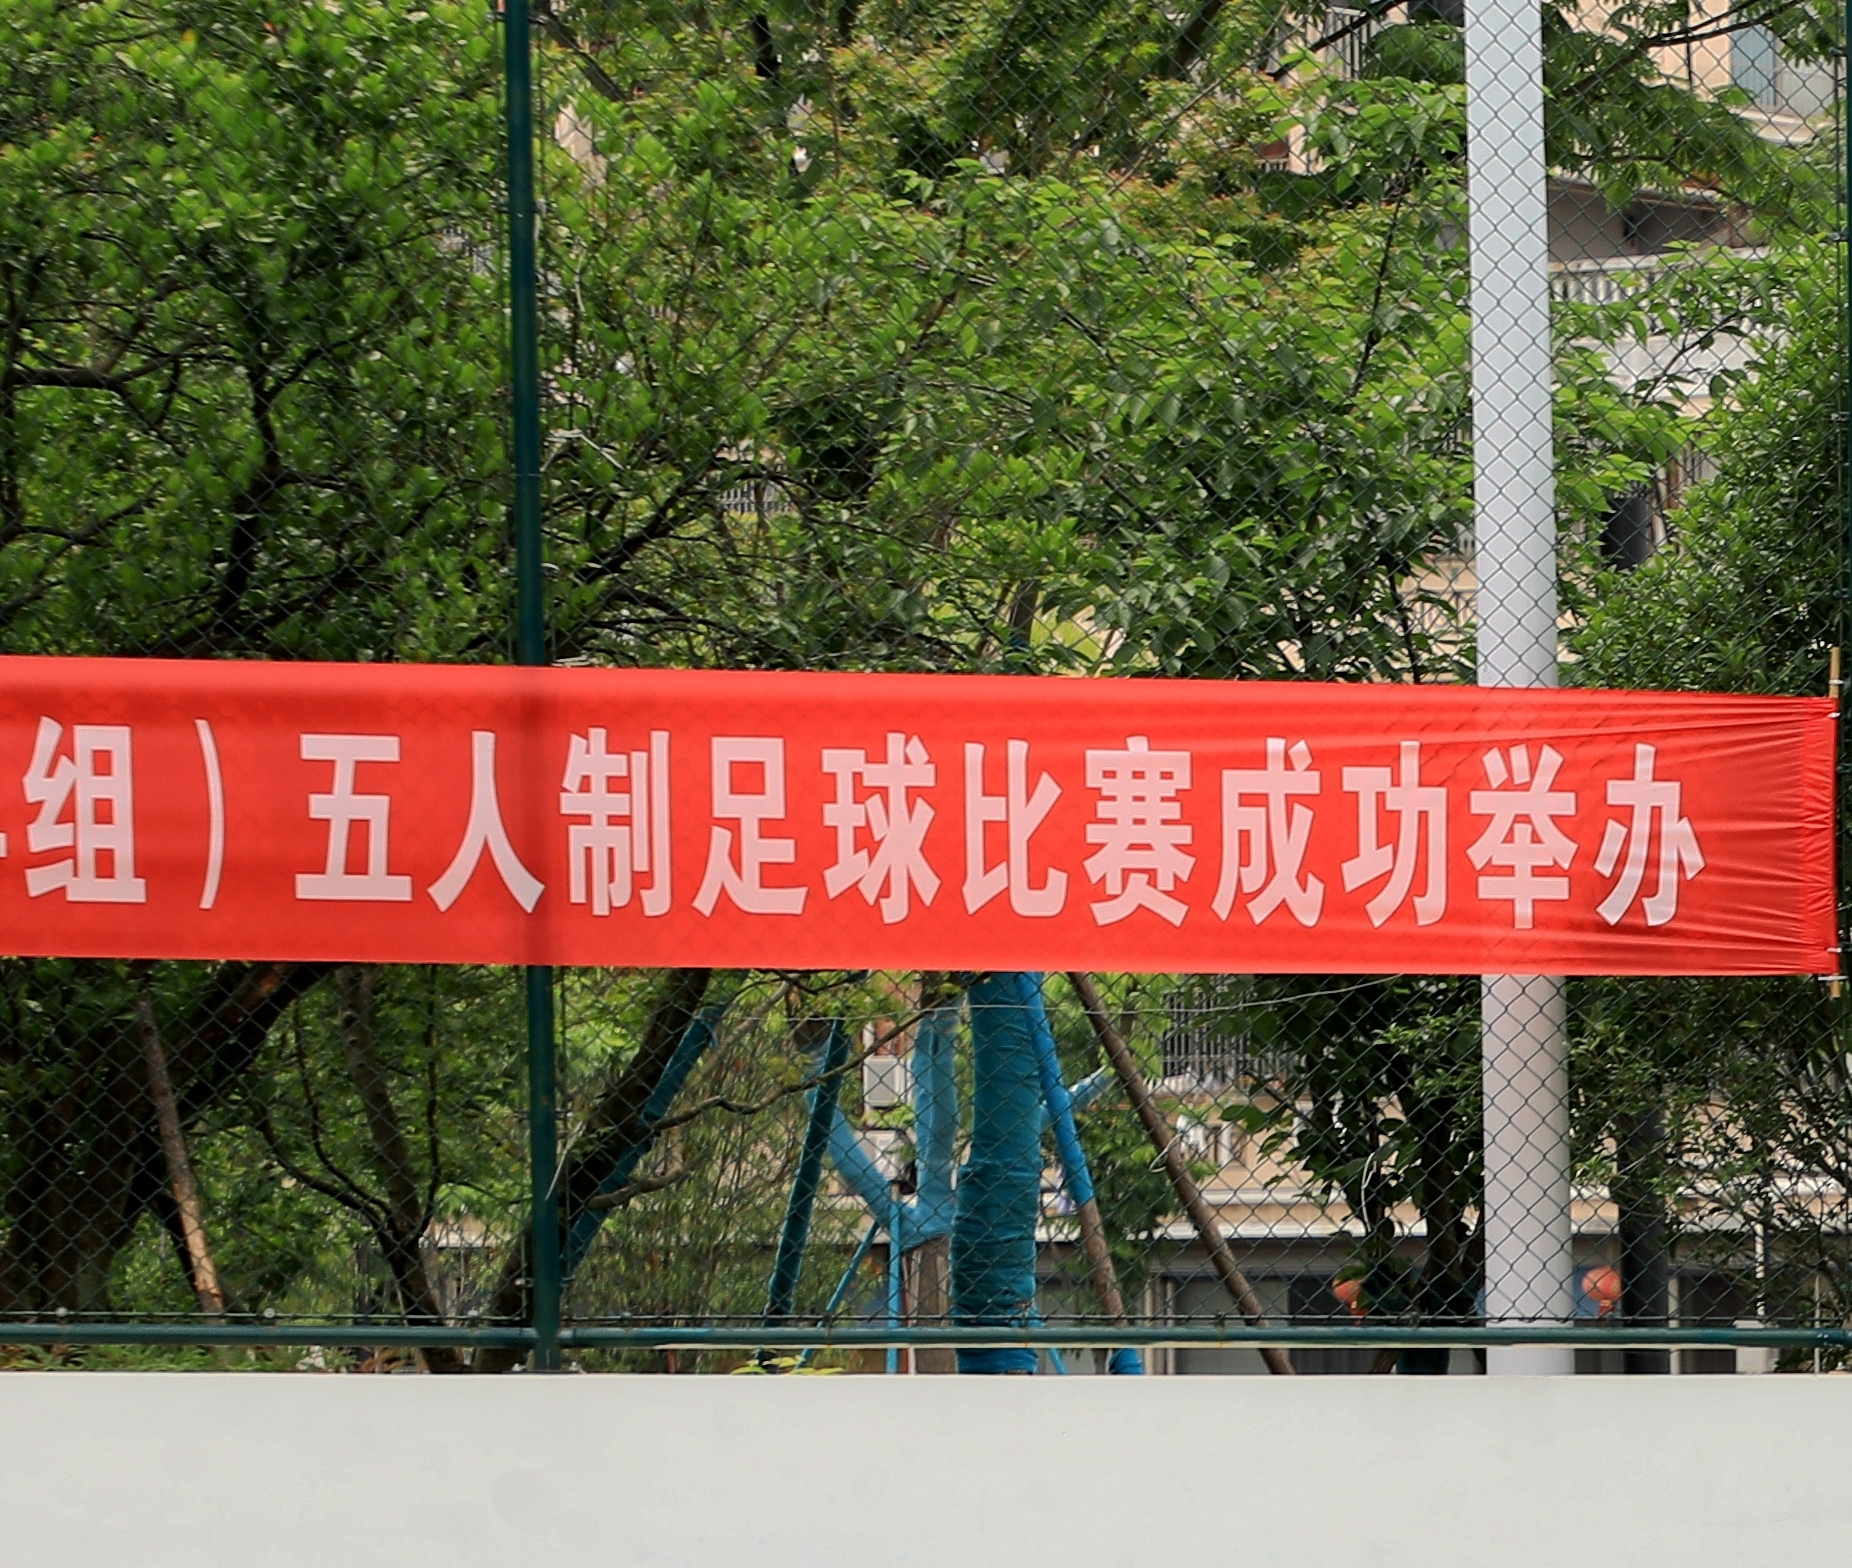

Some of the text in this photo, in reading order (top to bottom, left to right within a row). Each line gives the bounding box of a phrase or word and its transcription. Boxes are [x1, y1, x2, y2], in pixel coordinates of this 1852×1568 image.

[0, 716, 1705, 928] 组）五人制足球比赛成功举办
